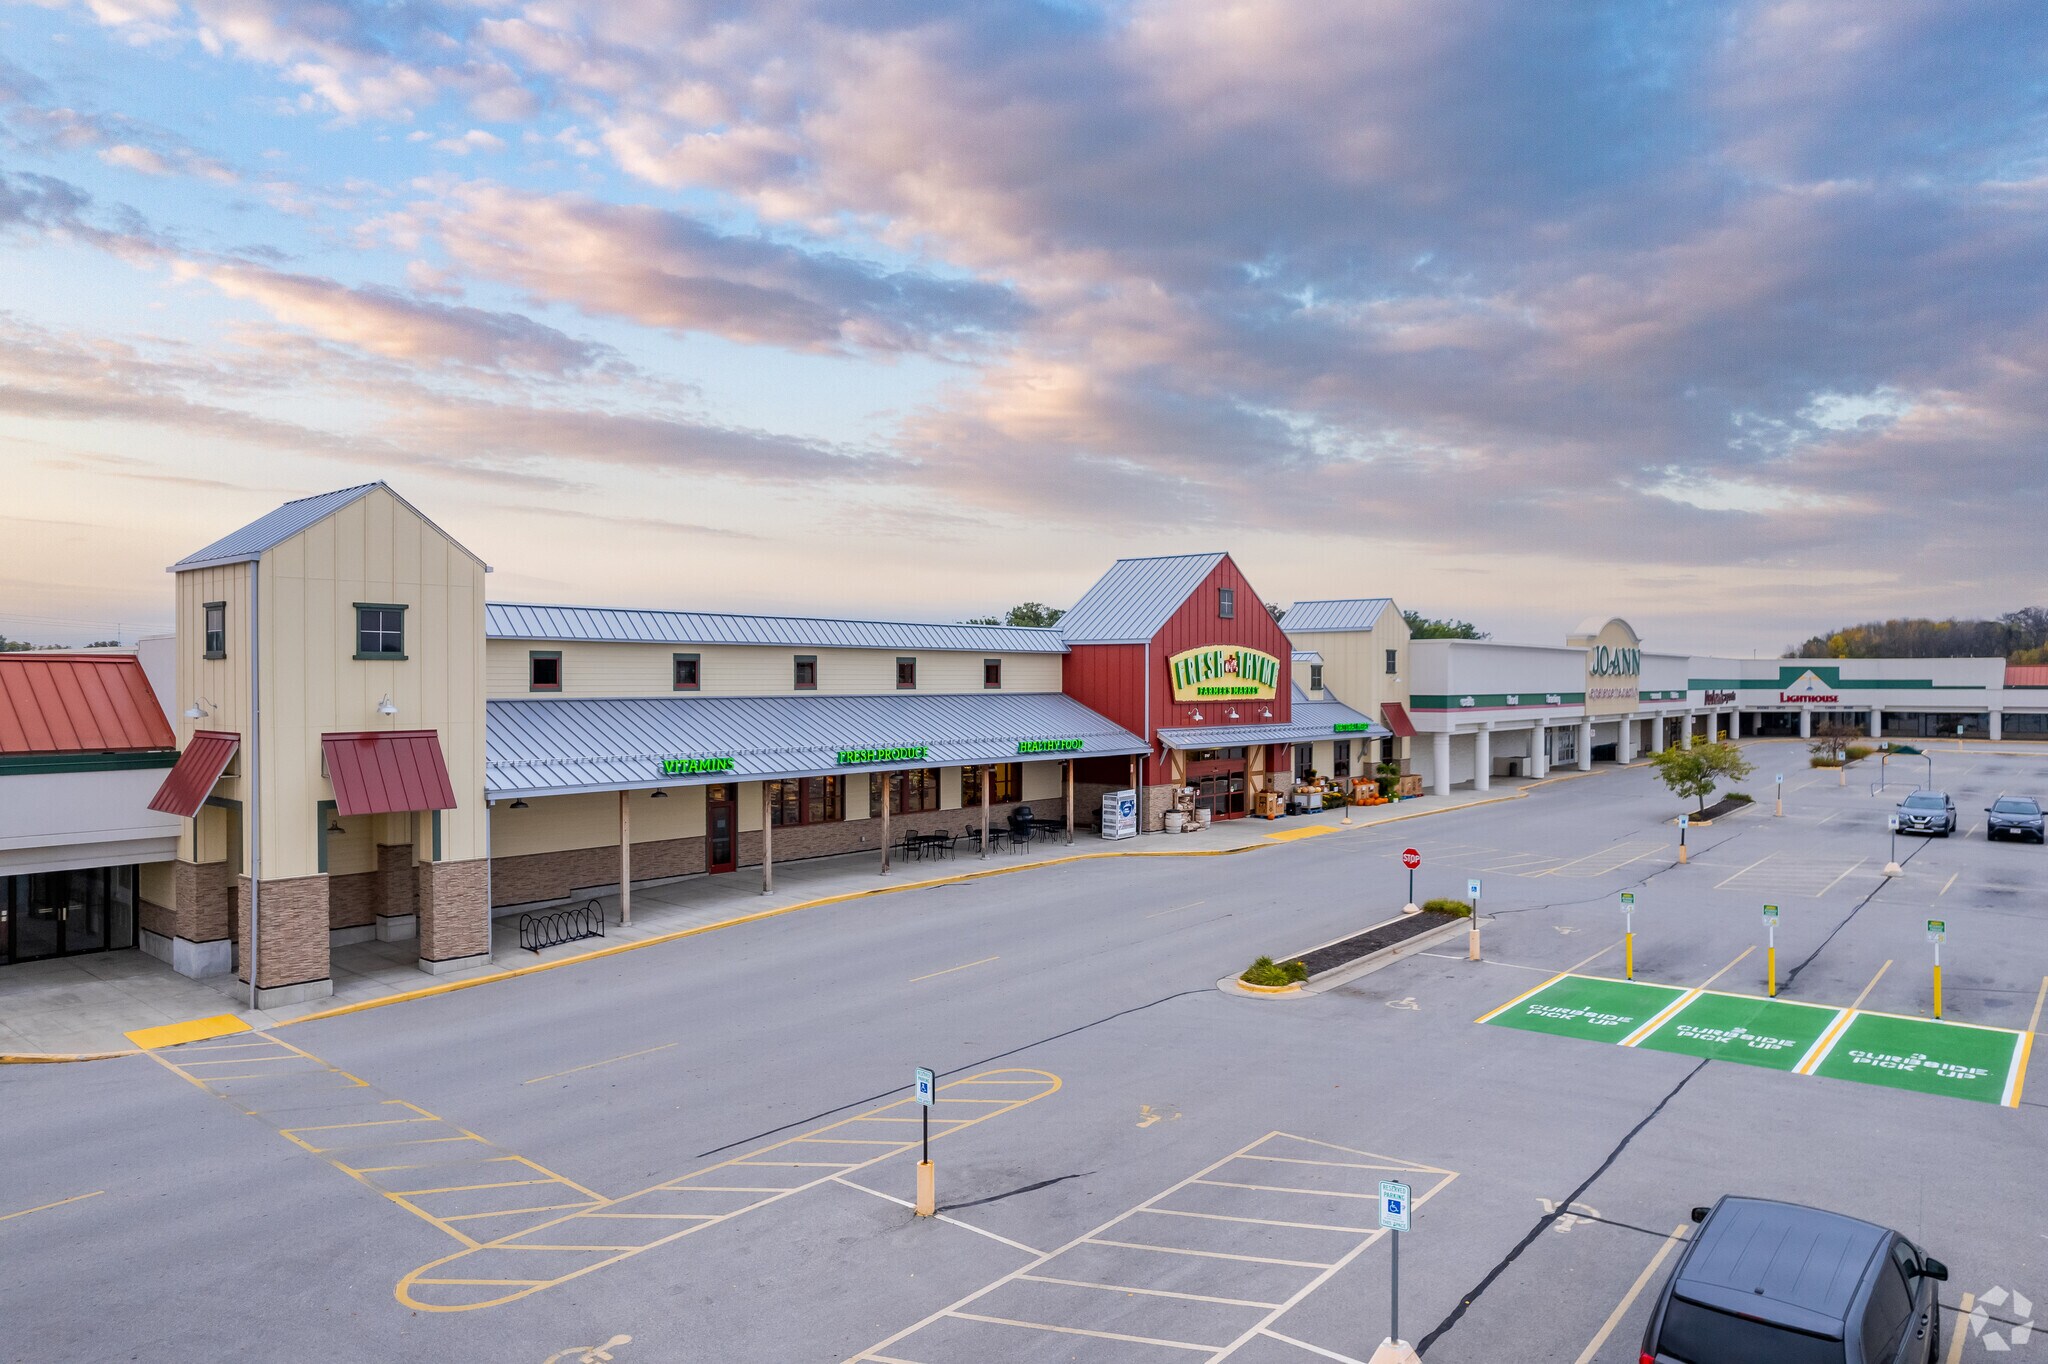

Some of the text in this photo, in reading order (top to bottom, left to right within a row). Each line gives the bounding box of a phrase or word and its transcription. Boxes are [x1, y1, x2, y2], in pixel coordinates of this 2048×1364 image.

[1175, 650, 1280, 689] FRESH THYME
[1197, 686, 1259, 696] FARMERS MARKET
[837, 746, 929, 765] FRESH PRODUCE
[1018, 739, 1084, 754] HEALTHY FOOD
[662, 757, 735, 776] VITAMINS
[1402, 853, 1420, 864] STOP
[1526, 1009, 1619, 1026] PICK UP
[1528, 1004, 1634, 1023] CURBSIDE
[1676, 1025, 1797, 1047] CURBSIDE
[1676, 1031, 1783, 1050] PICK UP
[1848, 1050, 1989, 1076] CURBSIDE
[1852, 1057, 1977, 1079] PICK UP
[1384, 1191, 1405, 1201] PARKING
